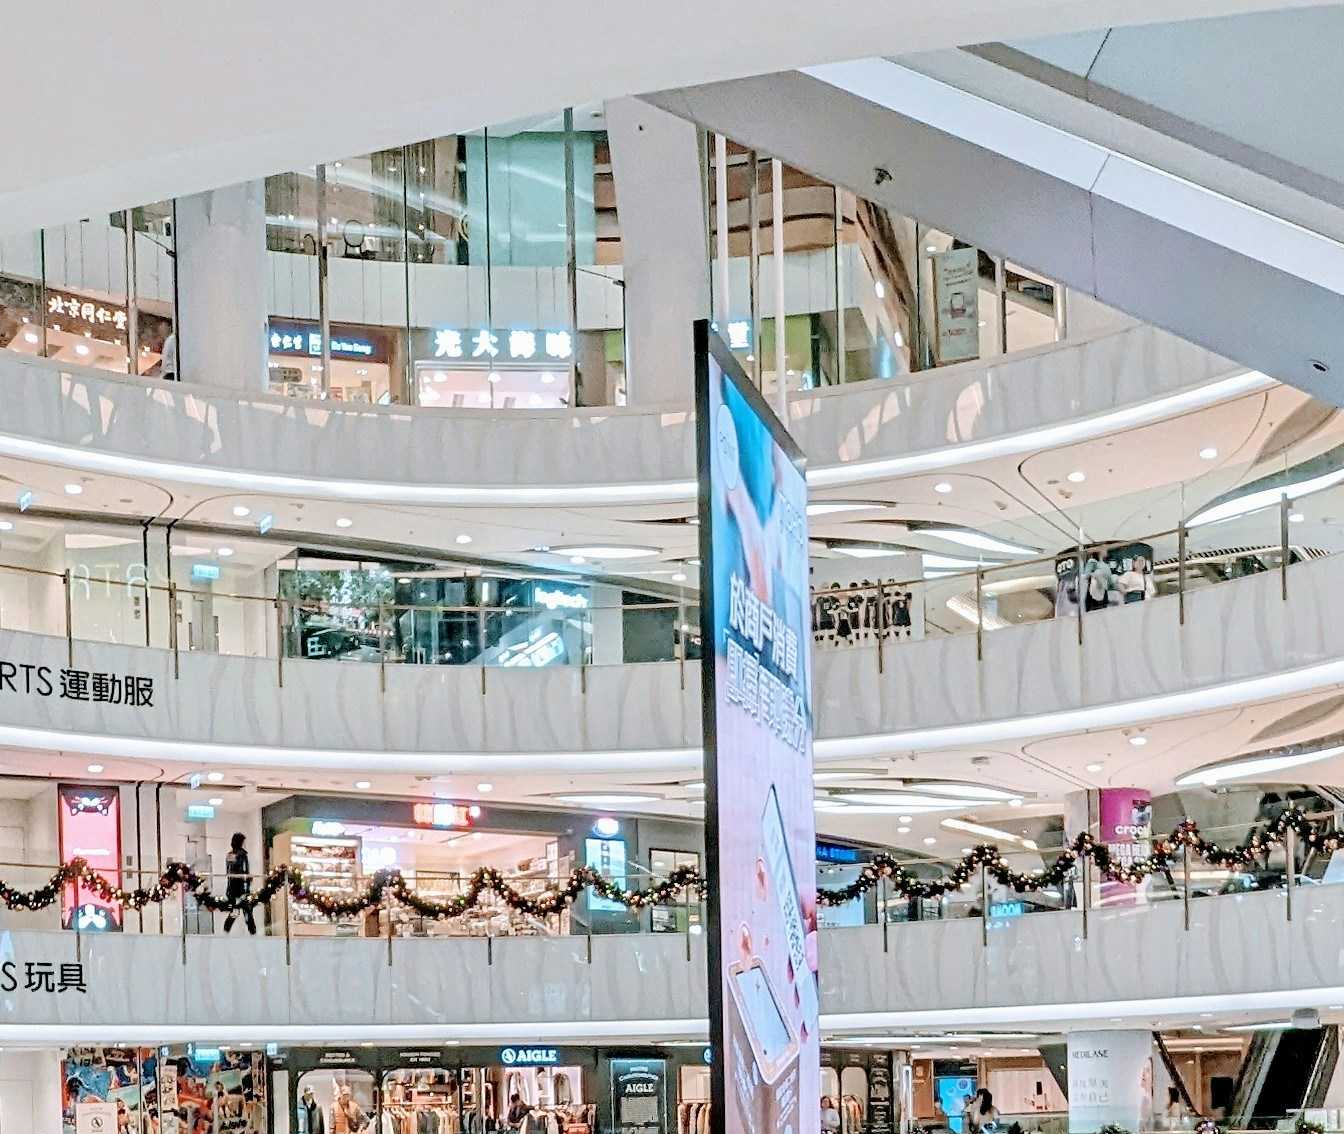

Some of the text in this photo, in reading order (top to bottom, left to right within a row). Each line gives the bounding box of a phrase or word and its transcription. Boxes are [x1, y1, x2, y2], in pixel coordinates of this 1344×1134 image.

[60, 668, 155, 708] 運動服
[25, 960, 88, 994] 玩具
[517, 1050, 558, 1062] AIGLE
[625, 1083, 654, 1093] AIGLE
